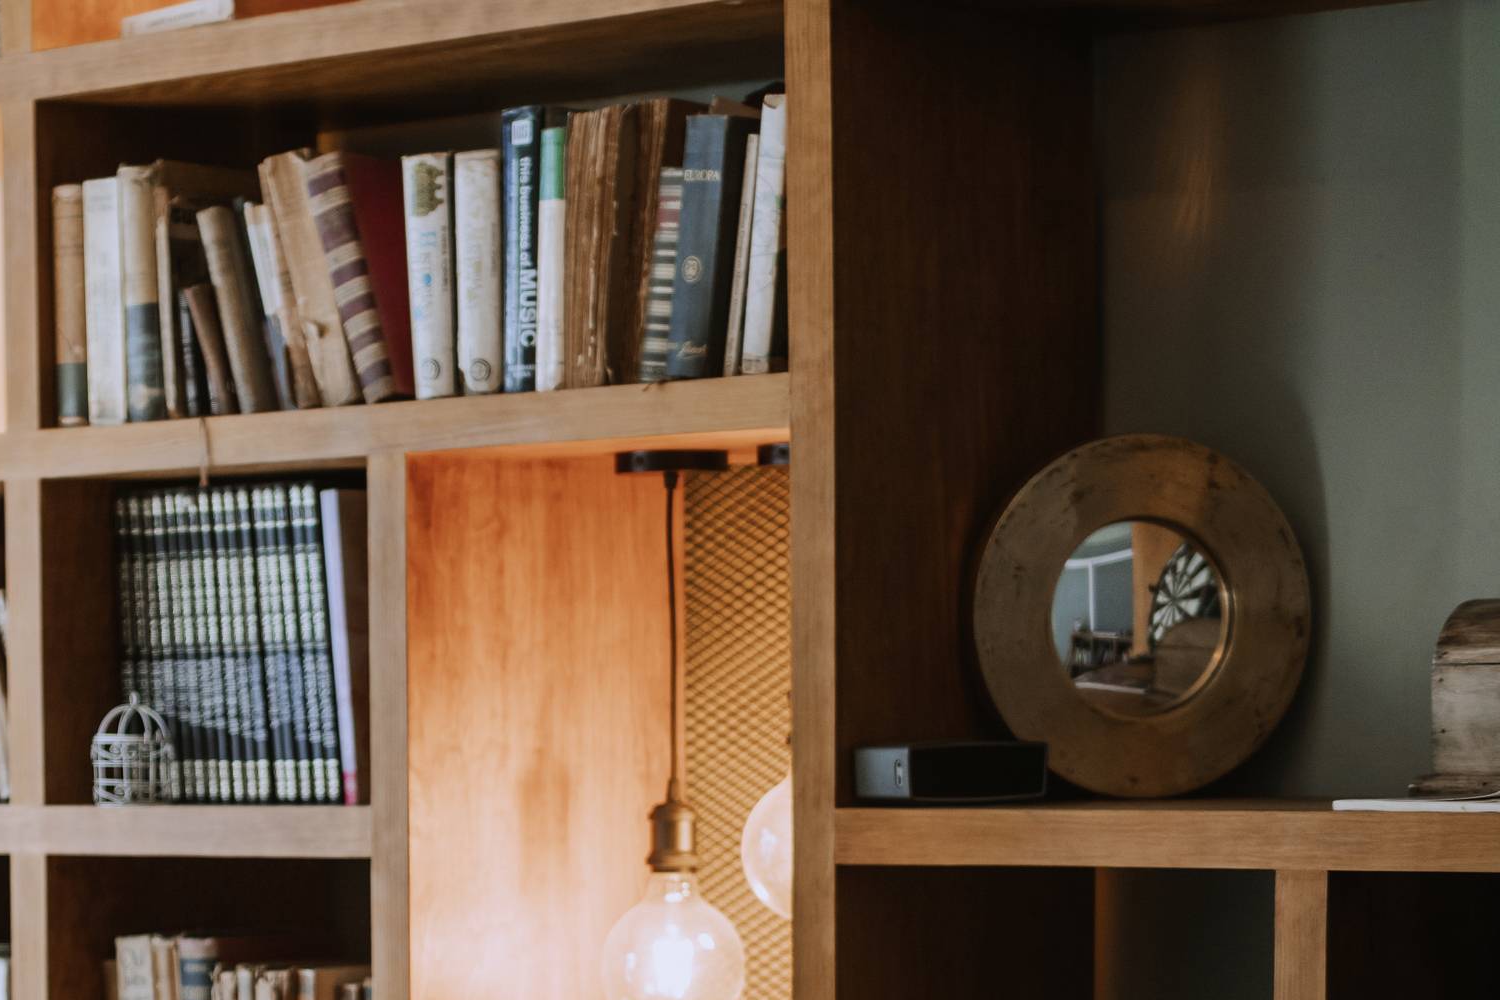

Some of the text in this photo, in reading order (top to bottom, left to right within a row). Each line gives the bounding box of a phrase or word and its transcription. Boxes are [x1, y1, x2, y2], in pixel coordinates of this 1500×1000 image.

[684, 168, 721, 182] EUROPA
[519, 157, 537, 347] this business of MUSIC
